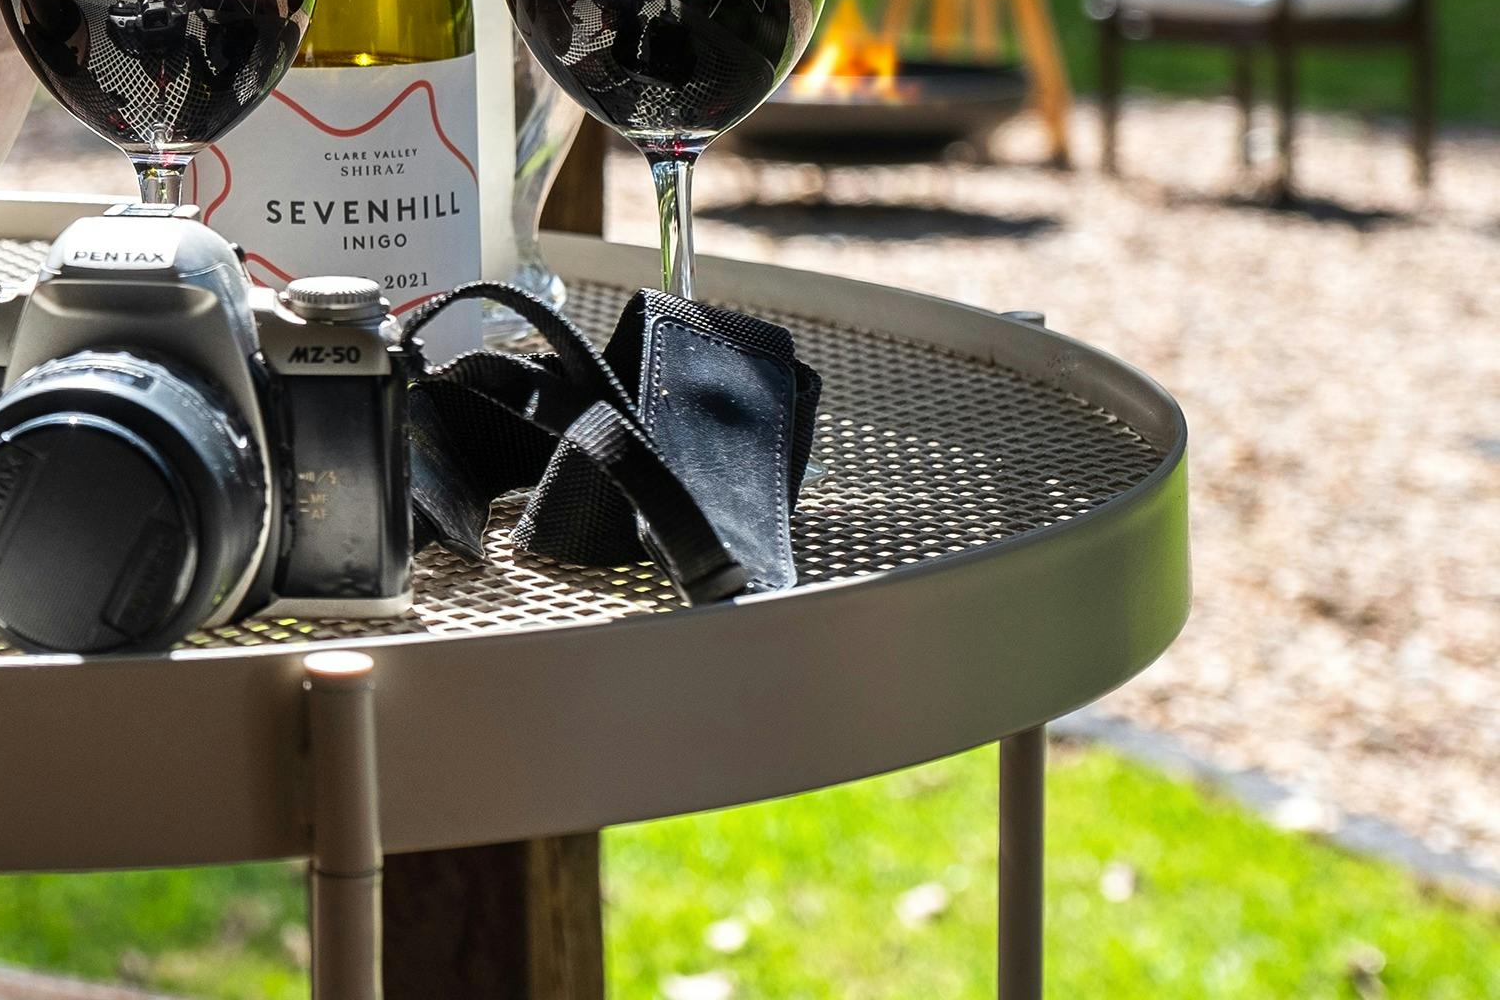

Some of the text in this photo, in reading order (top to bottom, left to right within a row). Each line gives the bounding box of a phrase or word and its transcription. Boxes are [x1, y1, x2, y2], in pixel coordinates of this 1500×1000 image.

[324, 148, 419, 161] CLARE VALLEY
[340, 163, 406, 177] SHIRAZ
[266, 192, 460, 224] SEVENHILL
[343, 233, 408, 251] INIGO
[73, 250, 165, 263] PENTAX
[384, 272, 429, 290] 2021
[288, 345, 361, 365] MZ-50
